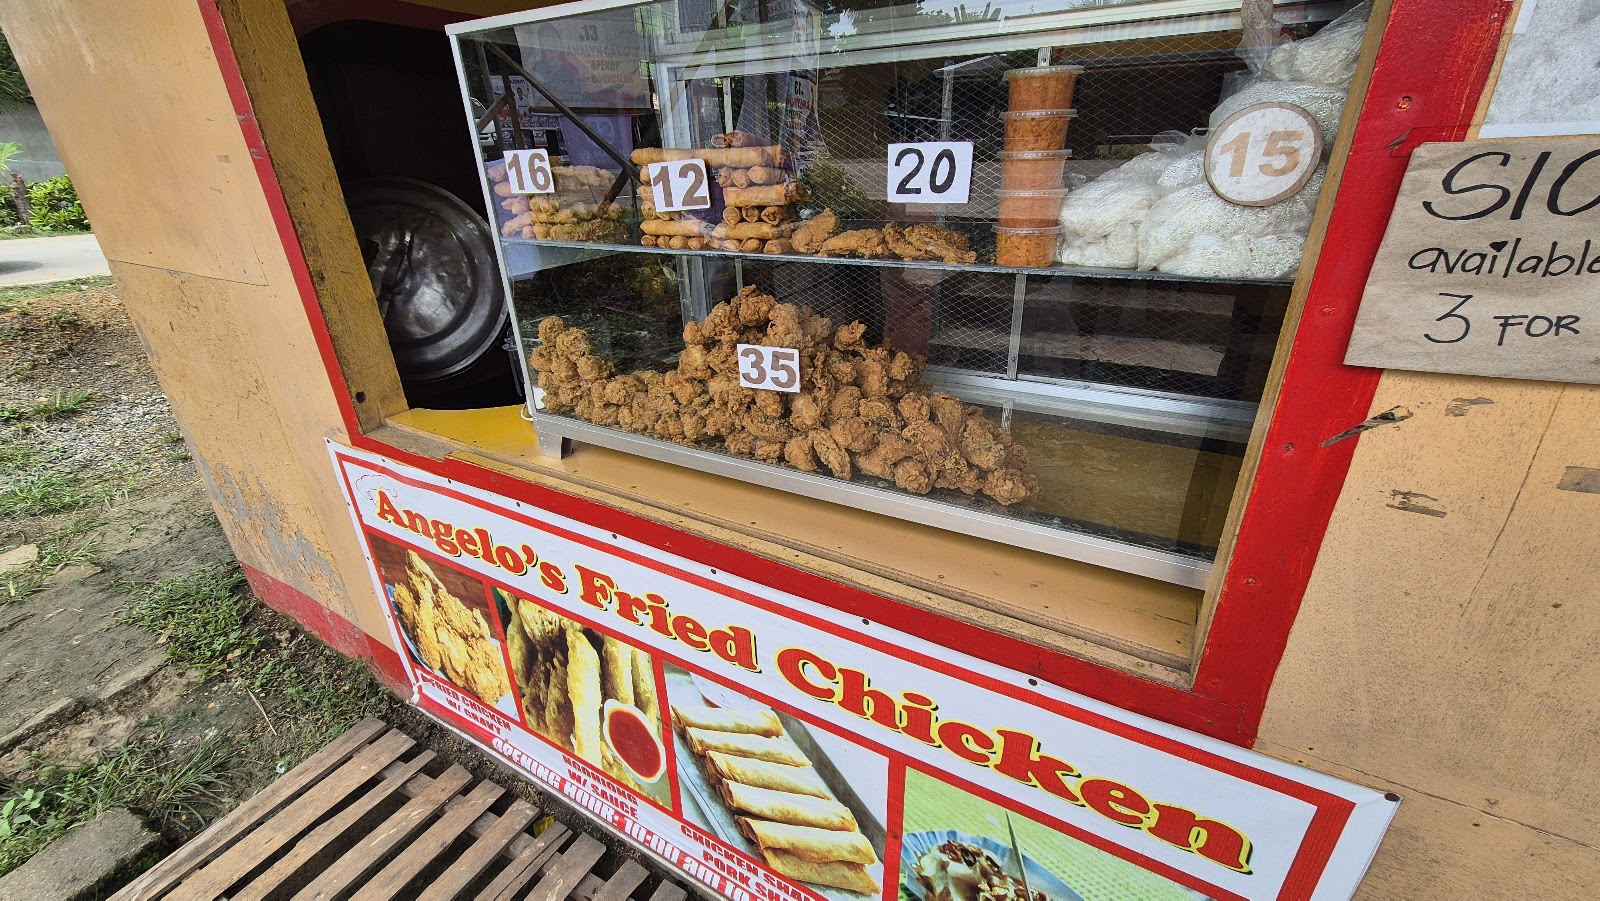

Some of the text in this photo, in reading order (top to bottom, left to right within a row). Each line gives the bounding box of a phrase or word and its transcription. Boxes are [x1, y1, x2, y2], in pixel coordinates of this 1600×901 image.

[507, 152, 551, 191] 16
[894, 148, 957, 195] 20
[1219, 130, 1306, 178] 15
[652, 163, 708, 208] 12
[1424, 293, 1581, 346] 3 FOR
[740, 347, 797, 389] 35
[375, 489, 1253, 875] Angelo's Fried Chicken
[430, 678, 512, 732] FRIED CHICKEN
[463, 708, 501, 735] GRAVY
[492, 737, 560, 790] OPENING
[563, 779, 620, 826] HOUR:
[624, 817, 680, 864] 10:00
[562, 755, 638, 806] NGOHIONG
[567, 769, 639, 821] W/ SAUCE
[680, 825, 758, 877] CHICKEN
[703, 849, 752, 889] PORK
